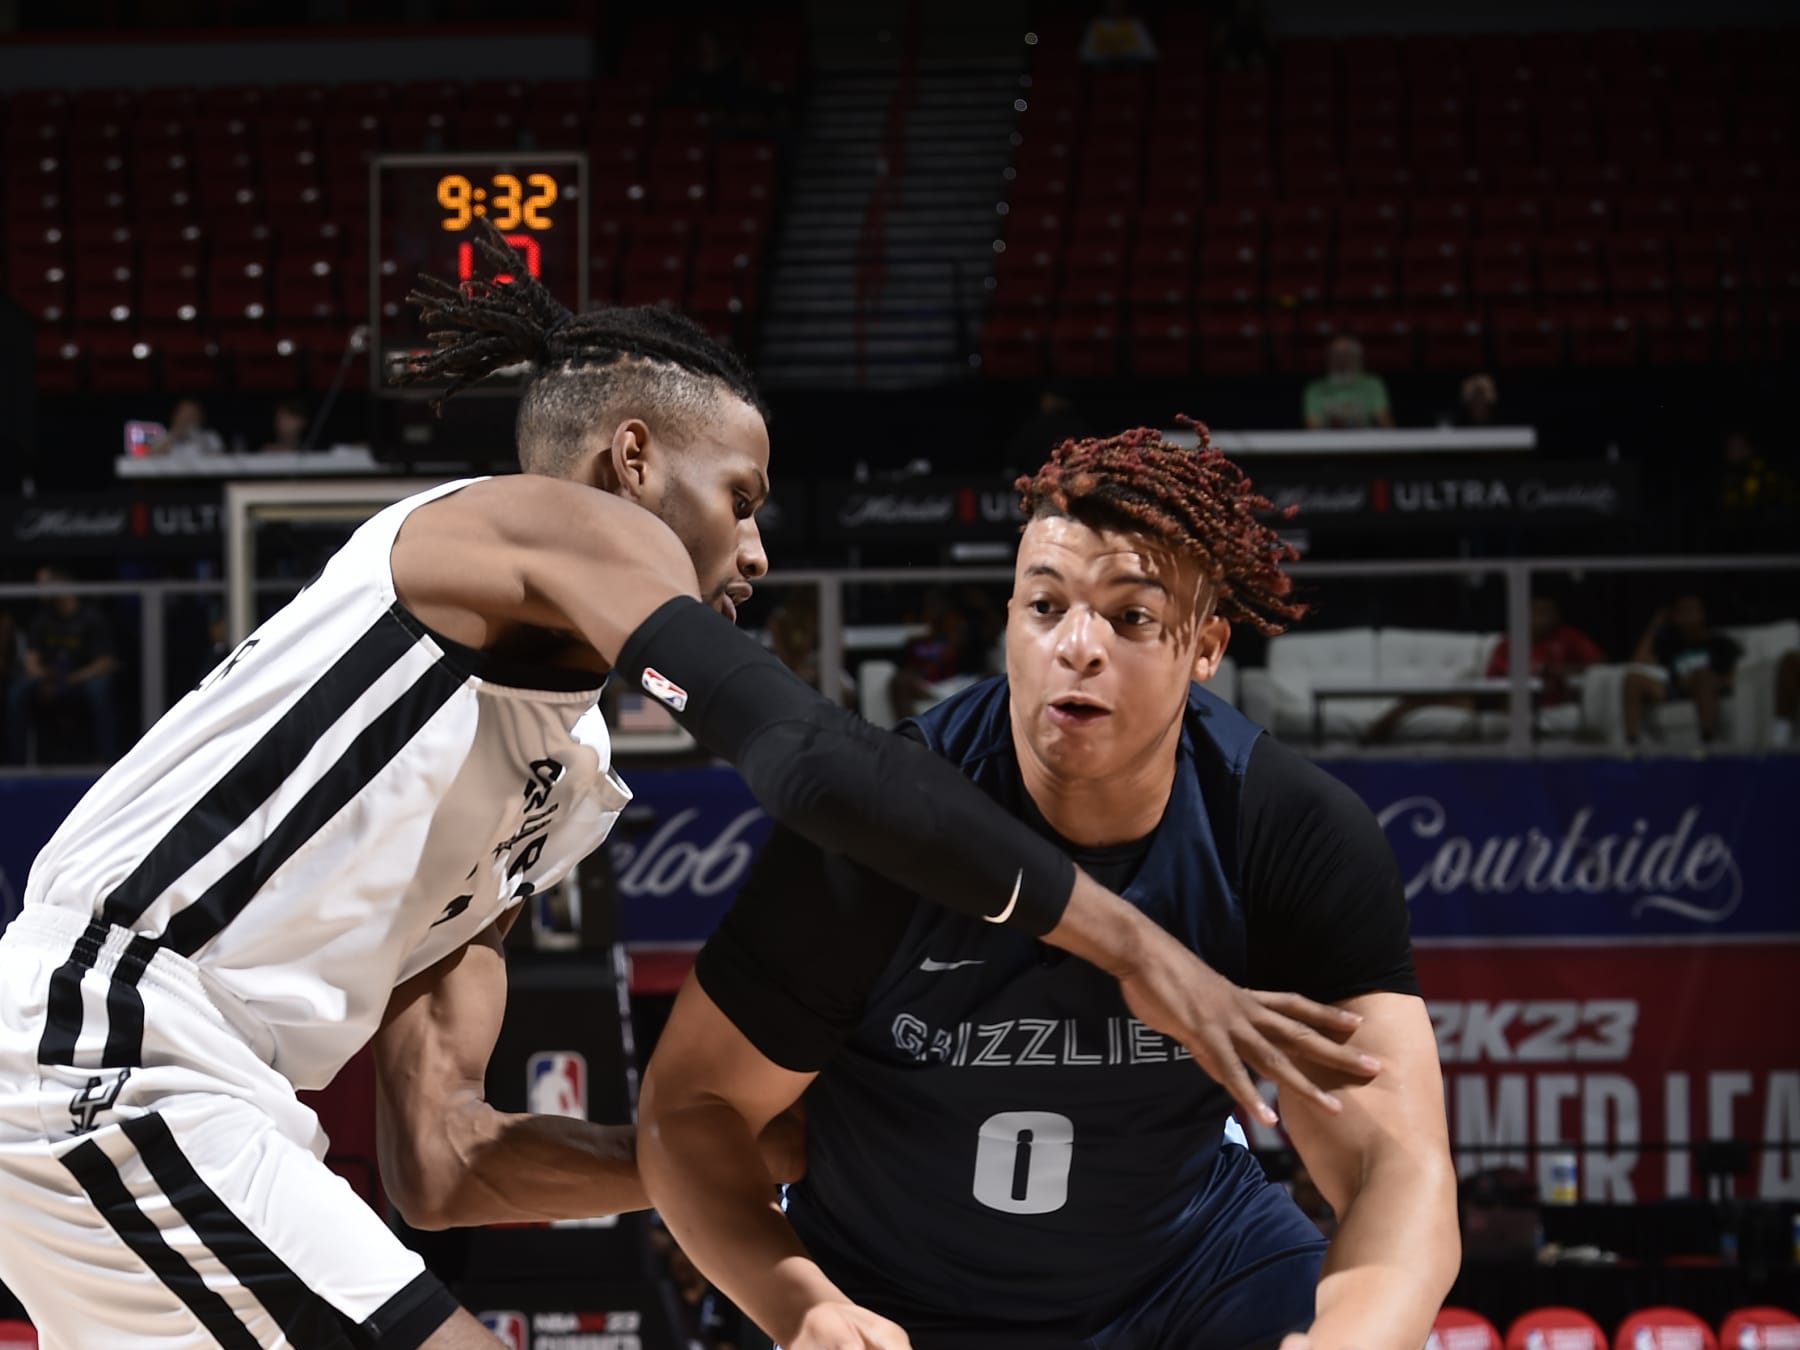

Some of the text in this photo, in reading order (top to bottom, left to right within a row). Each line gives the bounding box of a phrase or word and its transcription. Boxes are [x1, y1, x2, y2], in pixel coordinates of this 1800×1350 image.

[436, 173, 558, 231] 9:32
[1395, 479, 1513, 513] ULTRA
[1377, 796, 1744, 923] Courtside
[892, 1013, 1198, 1067] GRIZZLIE
[1429, 1000, 1639, 1063] 2K23
[973, 1111, 1074, 1215] 0
